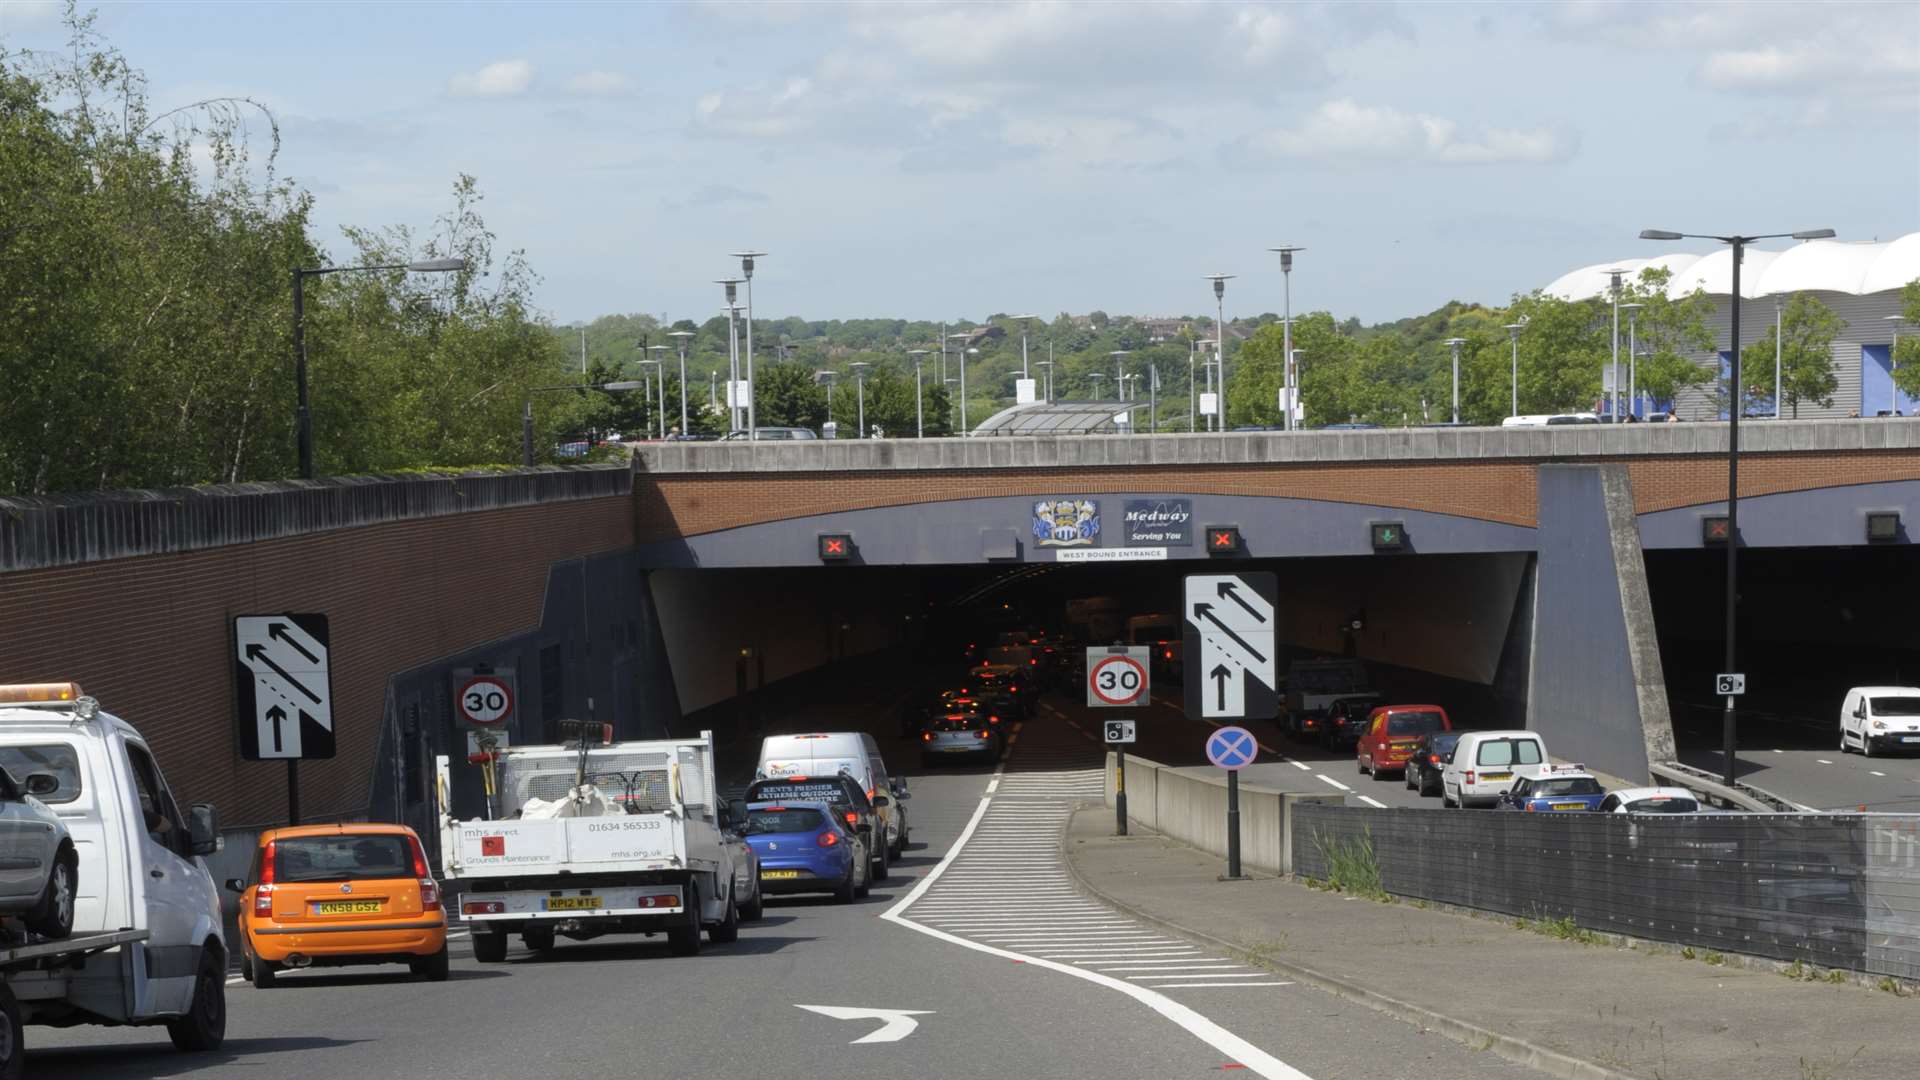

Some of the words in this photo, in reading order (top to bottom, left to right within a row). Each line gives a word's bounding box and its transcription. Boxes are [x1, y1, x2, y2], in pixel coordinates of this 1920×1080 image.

[1125, 511, 1189, 523] Medway
[1131, 533, 1163, 541] Serving
[1165, 532, 1181, 540] You
[1119, 550, 1161, 558] ENTRANCE
[1100, 671, 1139, 690] 30
[466, 692, 505, 712] 30
[770, 768, 796, 776] Dulux
[588, 823, 620, 832] 01634
[623, 821, 661, 831] 565333
[464, 829, 489, 837] mhs
[611, 847, 662, 858] mhs.org.uk
[466, 857, 500, 865] Grounds
[503, 855, 551, 863] Maintenance
[321, 903, 353, 913] KN58
